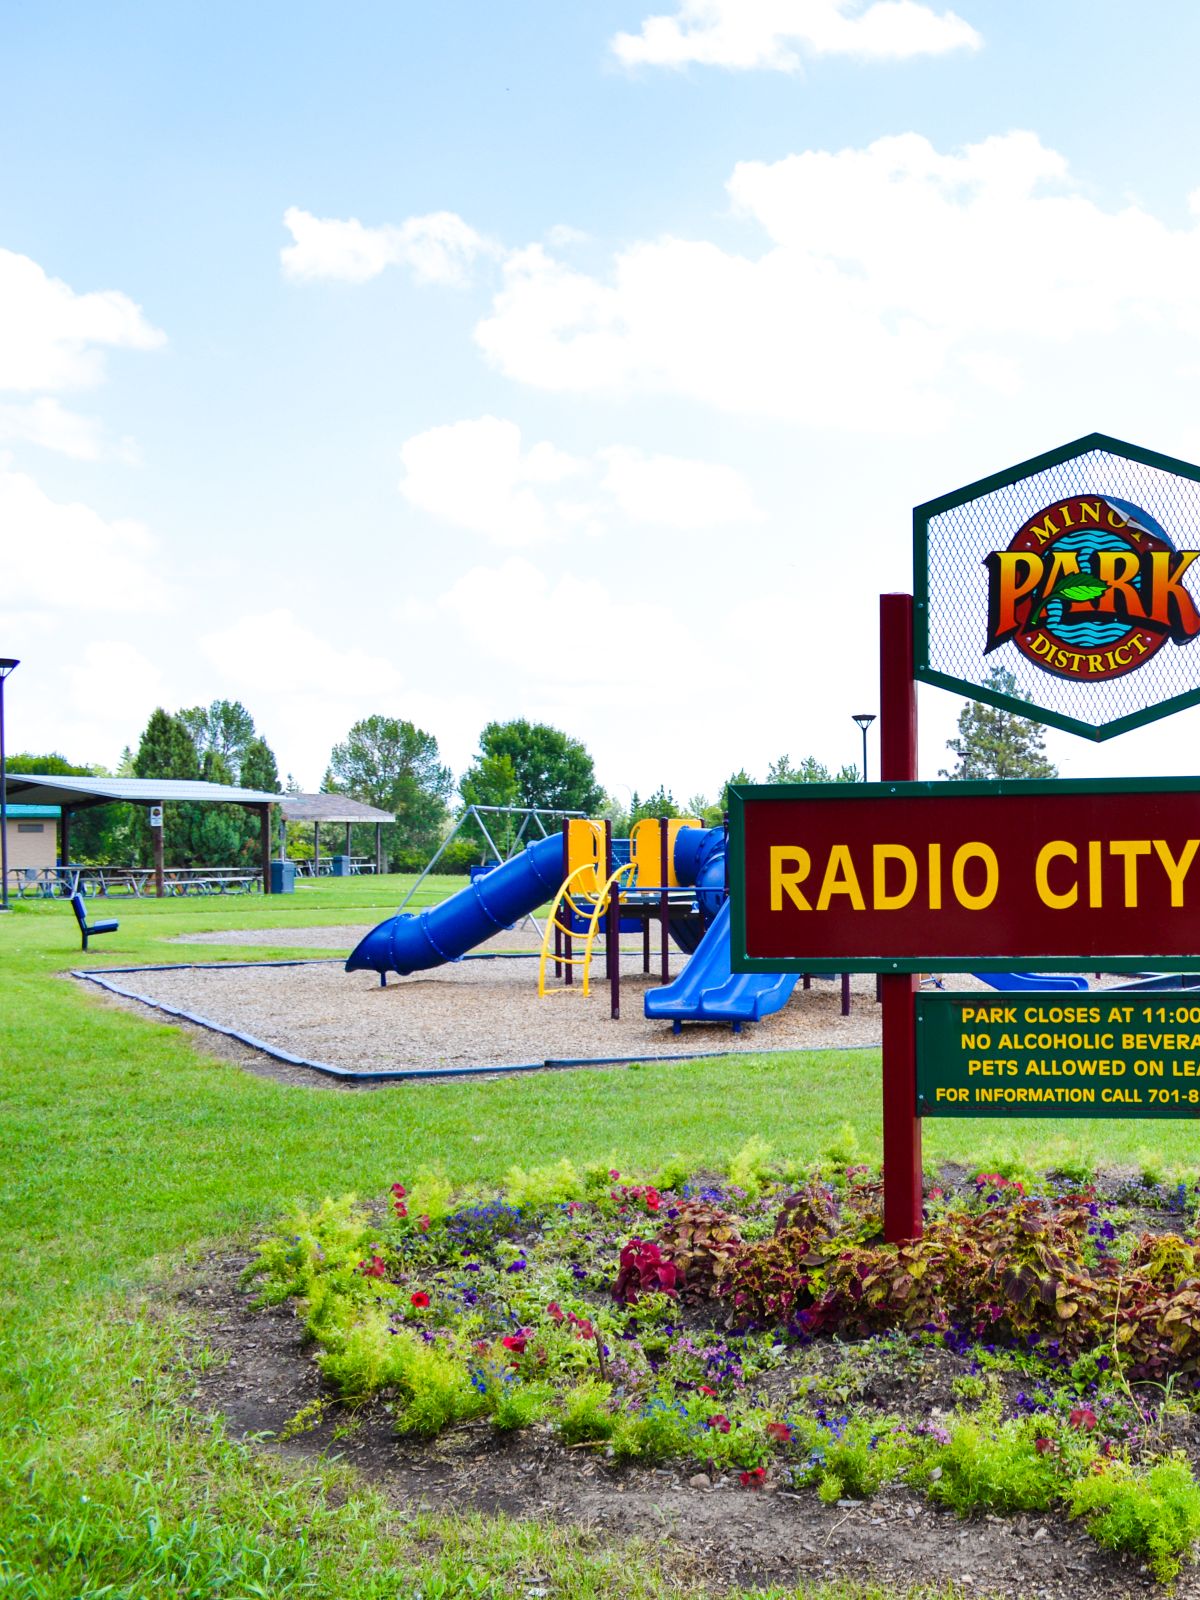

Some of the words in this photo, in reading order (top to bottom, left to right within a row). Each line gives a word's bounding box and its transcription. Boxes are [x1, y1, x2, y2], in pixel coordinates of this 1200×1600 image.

[1029, 632, 1149, 673] DISTRICT
[769, 841, 1000, 911] RADIO
[1035, 839, 1200, 910] CITY
[961, 1007, 1017, 1024] PARK
[1024, 1007, 1101, 1024] CLOSES
[1107, 1007, 1135, 1023] AT
[961, 1033, 991, 1050] NO
[998, 1033, 1114, 1050] ALCOHOLIC
[968, 1059, 1019, 1076] PETS
[1025, 1059, 1126, 1076] ALLOWED
[1133, 1059, 1164, 1077] ON
[936, 1087, 970, 1102] FOR
[975, 1087, 1095, 1103] INFORMATION
[1101, 1088, 1143, 1103] CALL
